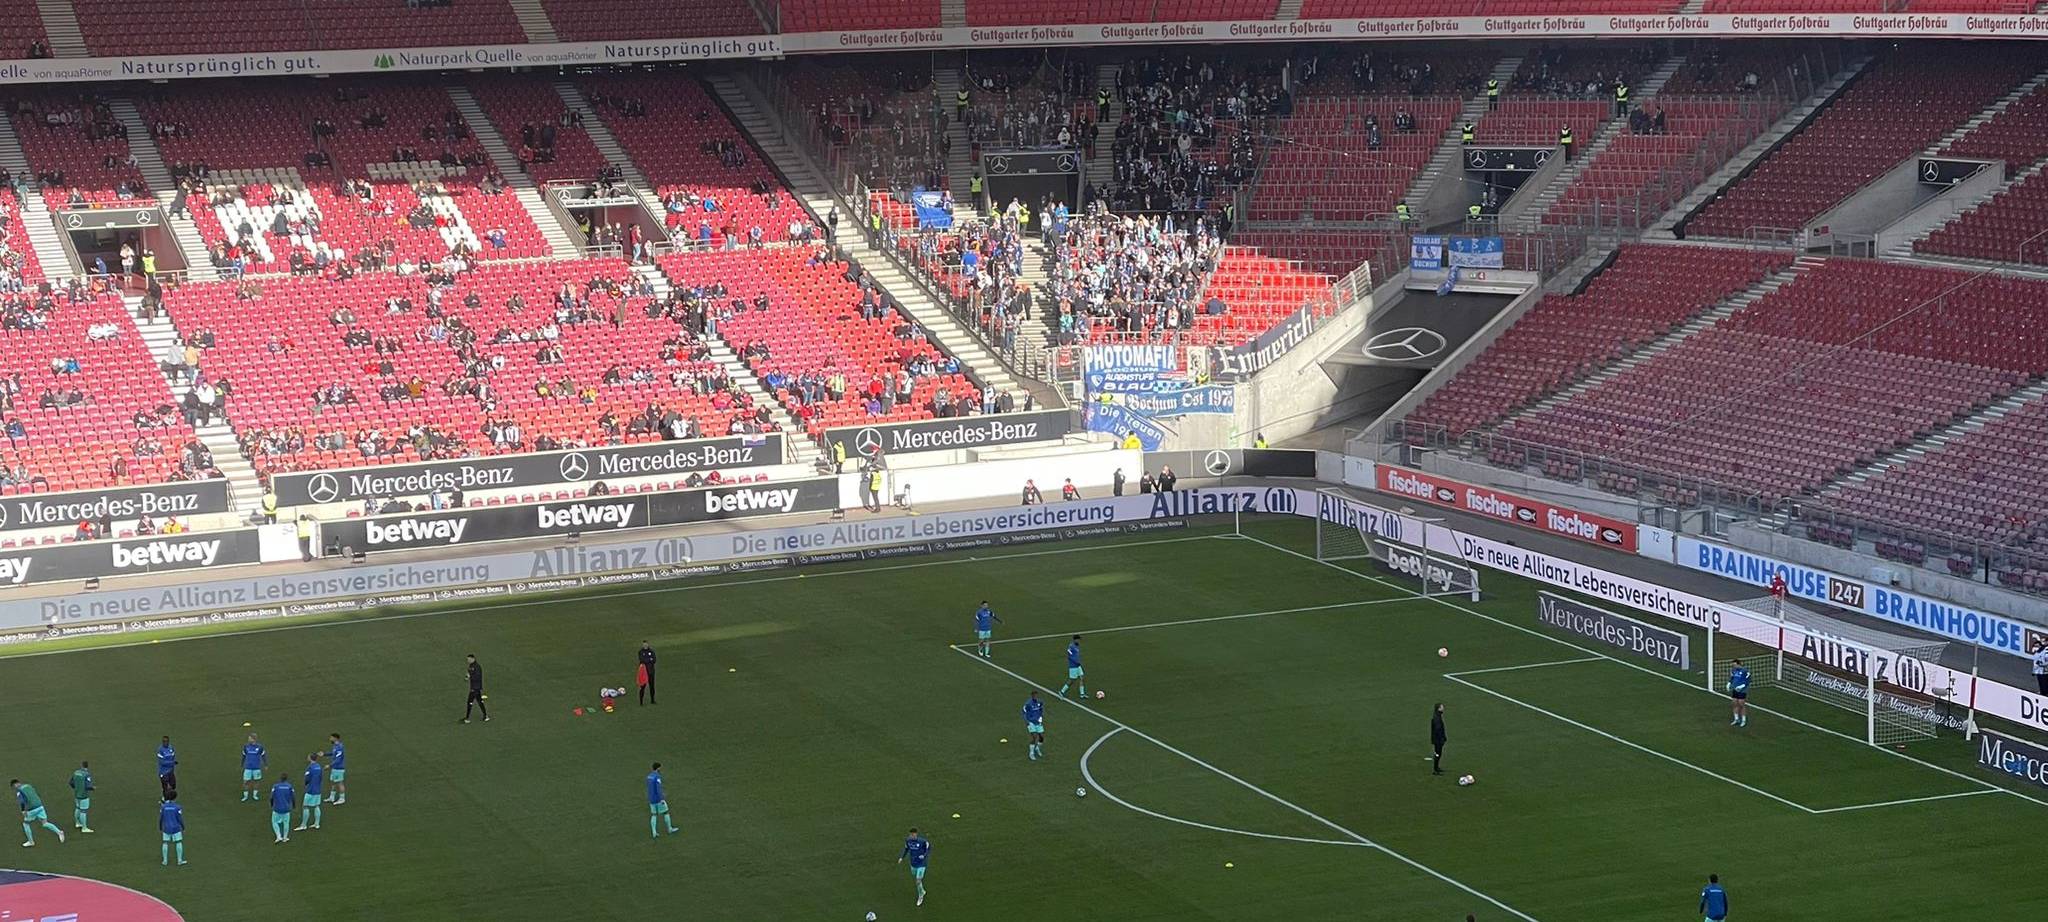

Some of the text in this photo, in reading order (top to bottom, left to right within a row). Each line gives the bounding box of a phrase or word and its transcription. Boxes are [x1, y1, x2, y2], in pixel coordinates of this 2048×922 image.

[970, 29, 1029, 43] Stuttgarter
[1100, 26, 1159, 40] Stuttgarter
[1229, 23, 1288, 36] Stuttgarter
[1357, 21, 1415, 34] Stuttgarter
[1484, 19, 1542, 33] Stuttgarter
[1609, 18, 1666, 32] Stuttgarter
[1731, 17, 1787, 31] Stuttgarter
[1853, 17, 1907, 31] Stuttgarter
[1966, 17, 2017, 32] Stuttgarter
[400, 51, 473, 68] Naturpark
[475, 49, 522, 65] Quelle
[527, 55, 544, 63] von
[604, 42, 744, 59] Natursprünglich
[747, 39, 781, 55] gut.
[839, 33, 897, 46] Stuttgarter
[33, 71, 52, 79] von
[121, 56, 276, 76] Natursprünglich
[284, 57, 321, 72] gut.
[1215, 306, 1313, 374] Emmerich
[1084, 345, 1177, 373] PHOTOMAFIA
[1103, 381, 1155, 391] BLAU
[1104, 373, 1155, 381] ALARMSTUFE
[1100, 406, 1120, 418] Die
[1127, 394, 1177, 414] Bochum
[1182, 391, 1204, 407] Ost
[892, 421, 1037, 450] Mercedes-Benz
[599, 445, 753, 475] Mercedes-Benz
[350, 464, 514, 496] Mercedes-Benz
[1388, 470, 1435, 499] fischer
[19, 490, 198, 525] Mercedes-Benz
[705, 488, 799, 514] betway
[1150, 488, 1257, 519] Allianz
[1319, 494, 1379, 536] Allianz
[1466, 488, 1514, 519] fischer
[537, 503, 635, 528] betway
[732, 503, 1115, 555] Die neue Allianz Lebensversicherung
[1547, 508, 1599, 540] fischer
[366, 517, 468, 544] betway
[1652, 531, 1660, 543] 72
[111, 539, 221, 568] betway
[530, 546, 647, 578] Allianz
[1387, 548, 1454, 592] betway
[1699, 544, 1826, 599] BRAINHOUSE
[40, 562, 490, 622] Die neue Allianz Lebensversicherung
[1463, 538, 1721, 631] Die neue Allianz Lebensversicherung
[1538, 596, 1680, 664] Mercedes-Benz
[1875, 589, 2021, 651] BRAINHOUSE
